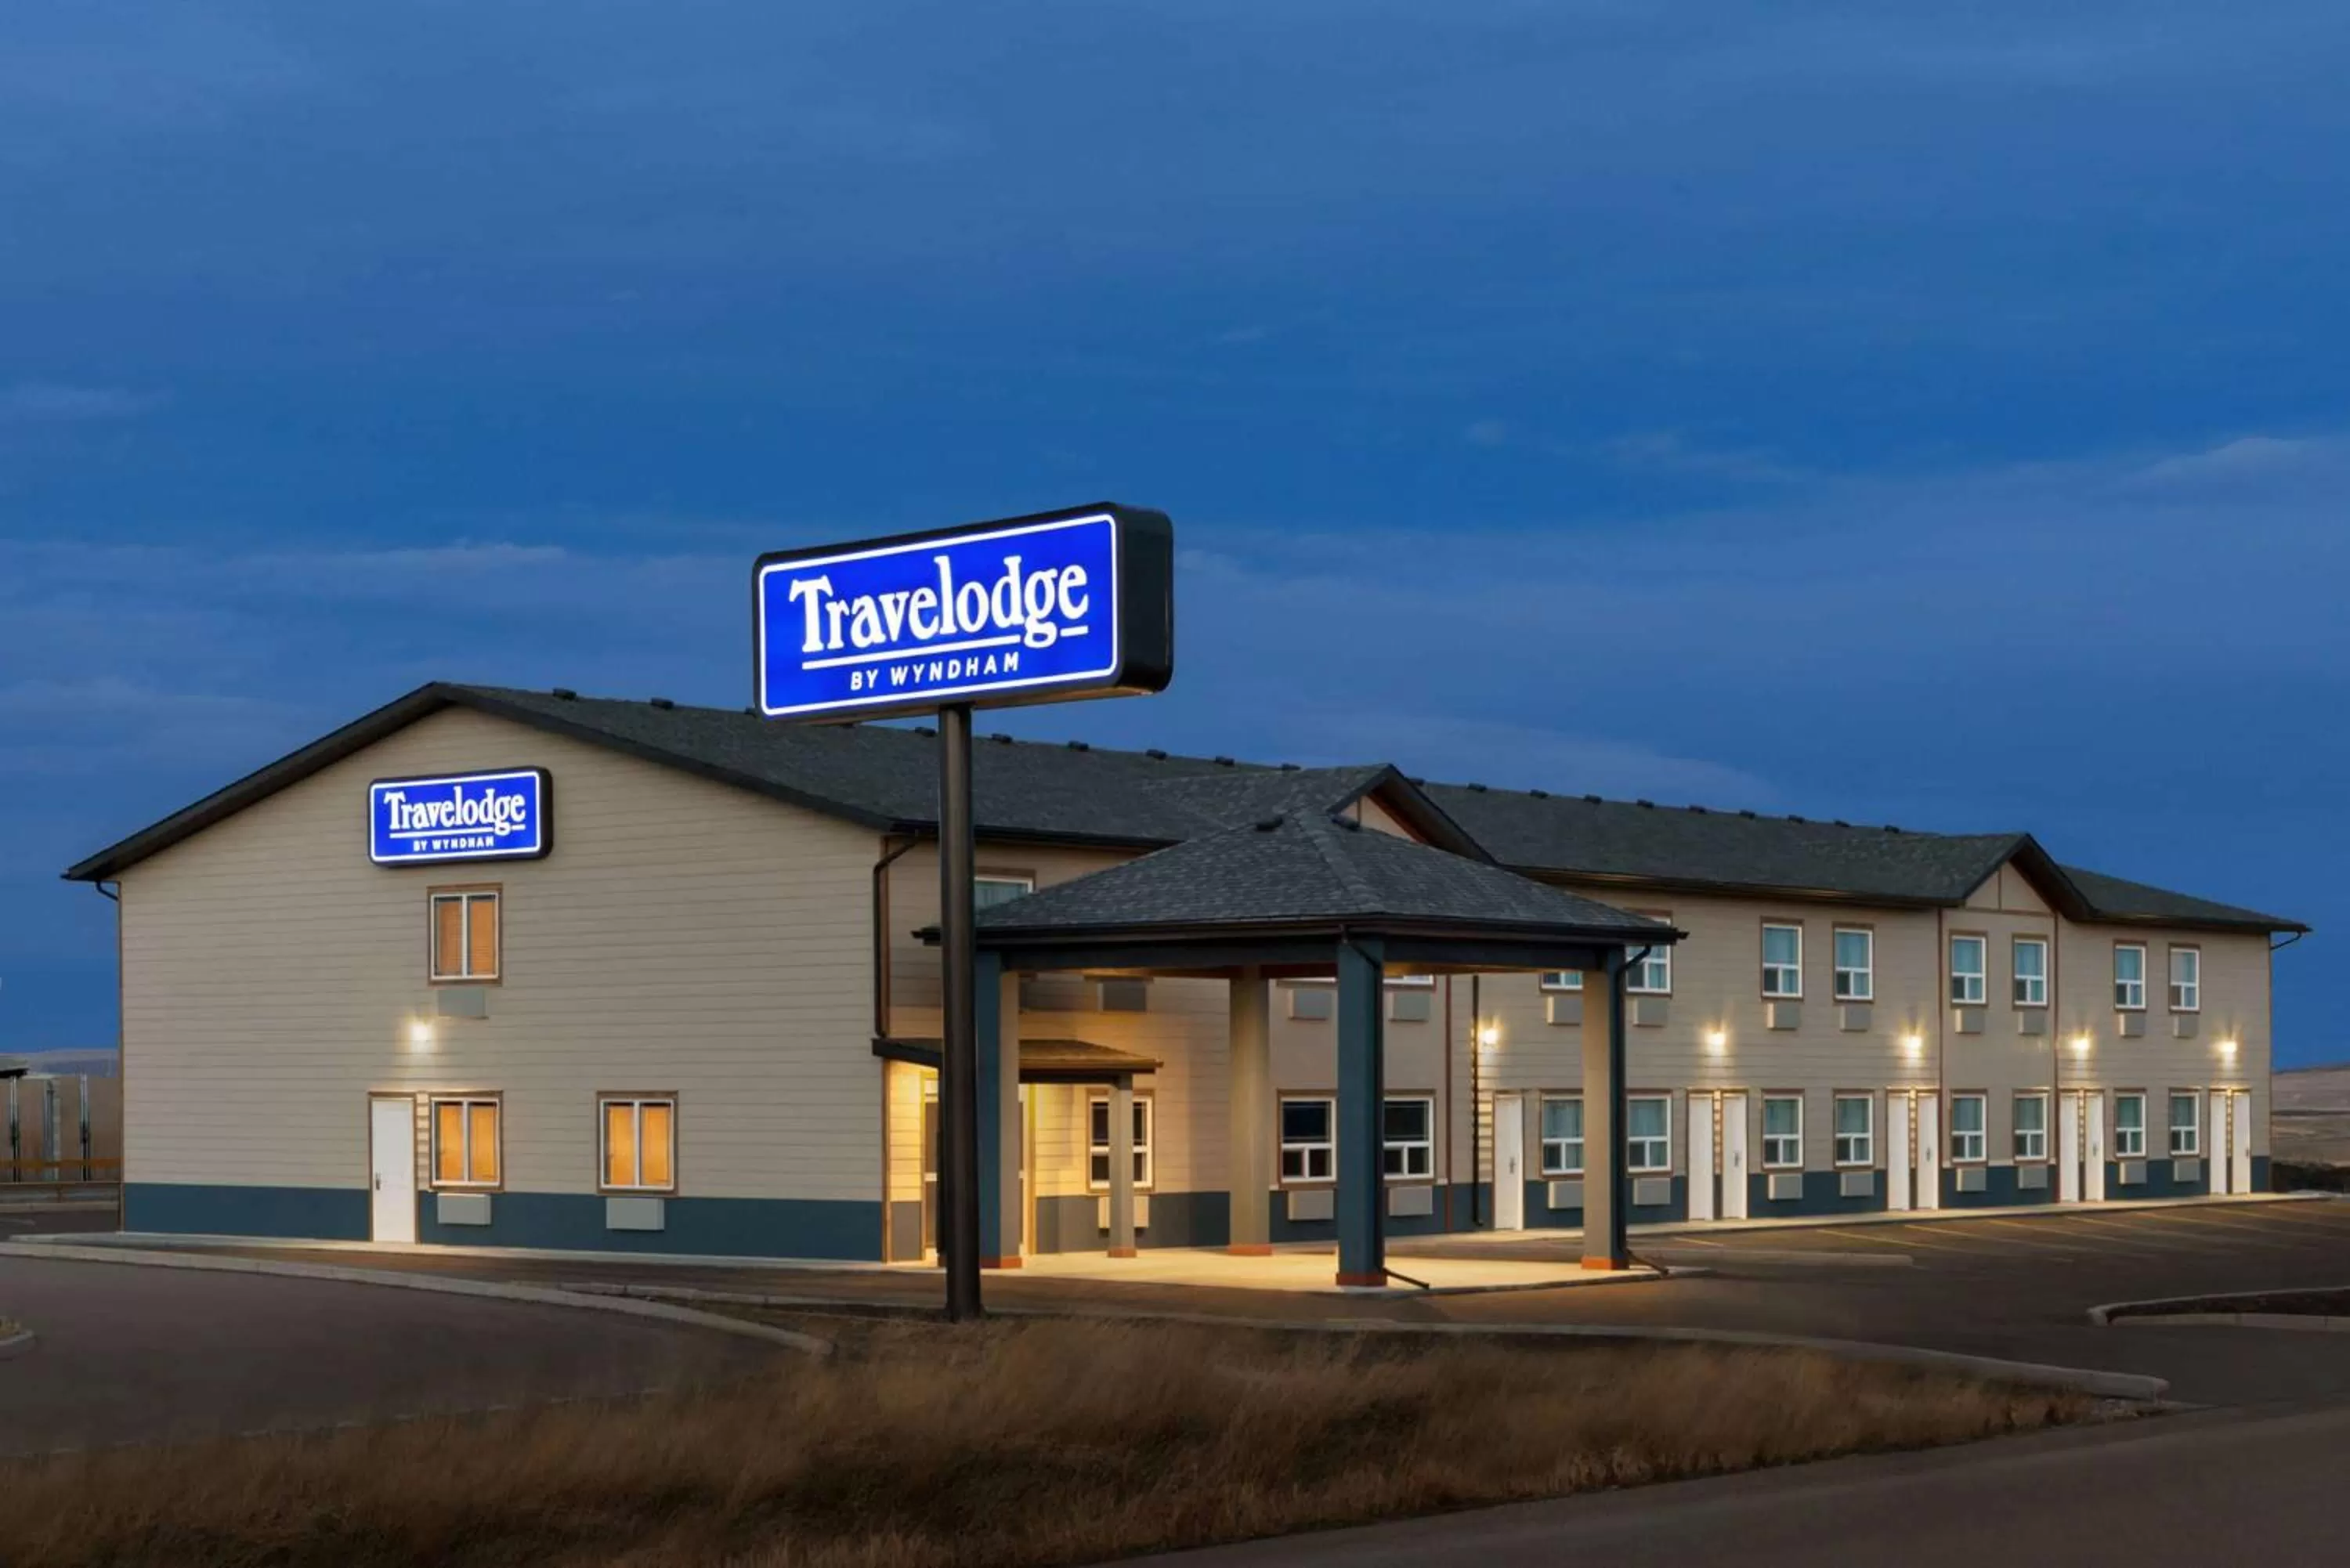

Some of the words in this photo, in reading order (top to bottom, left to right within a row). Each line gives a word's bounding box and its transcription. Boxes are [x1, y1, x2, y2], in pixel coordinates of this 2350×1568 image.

[789, 555, 1089, 652] Travelodge
[850, 669, 879, 691] BY
[891, 651, 1020, 685] WYNDHAM
[384, 786, 526, 836] Travelodge
[414, 840, 428, 852] BY
[432, 836, 494, 851] WYNDHAM
